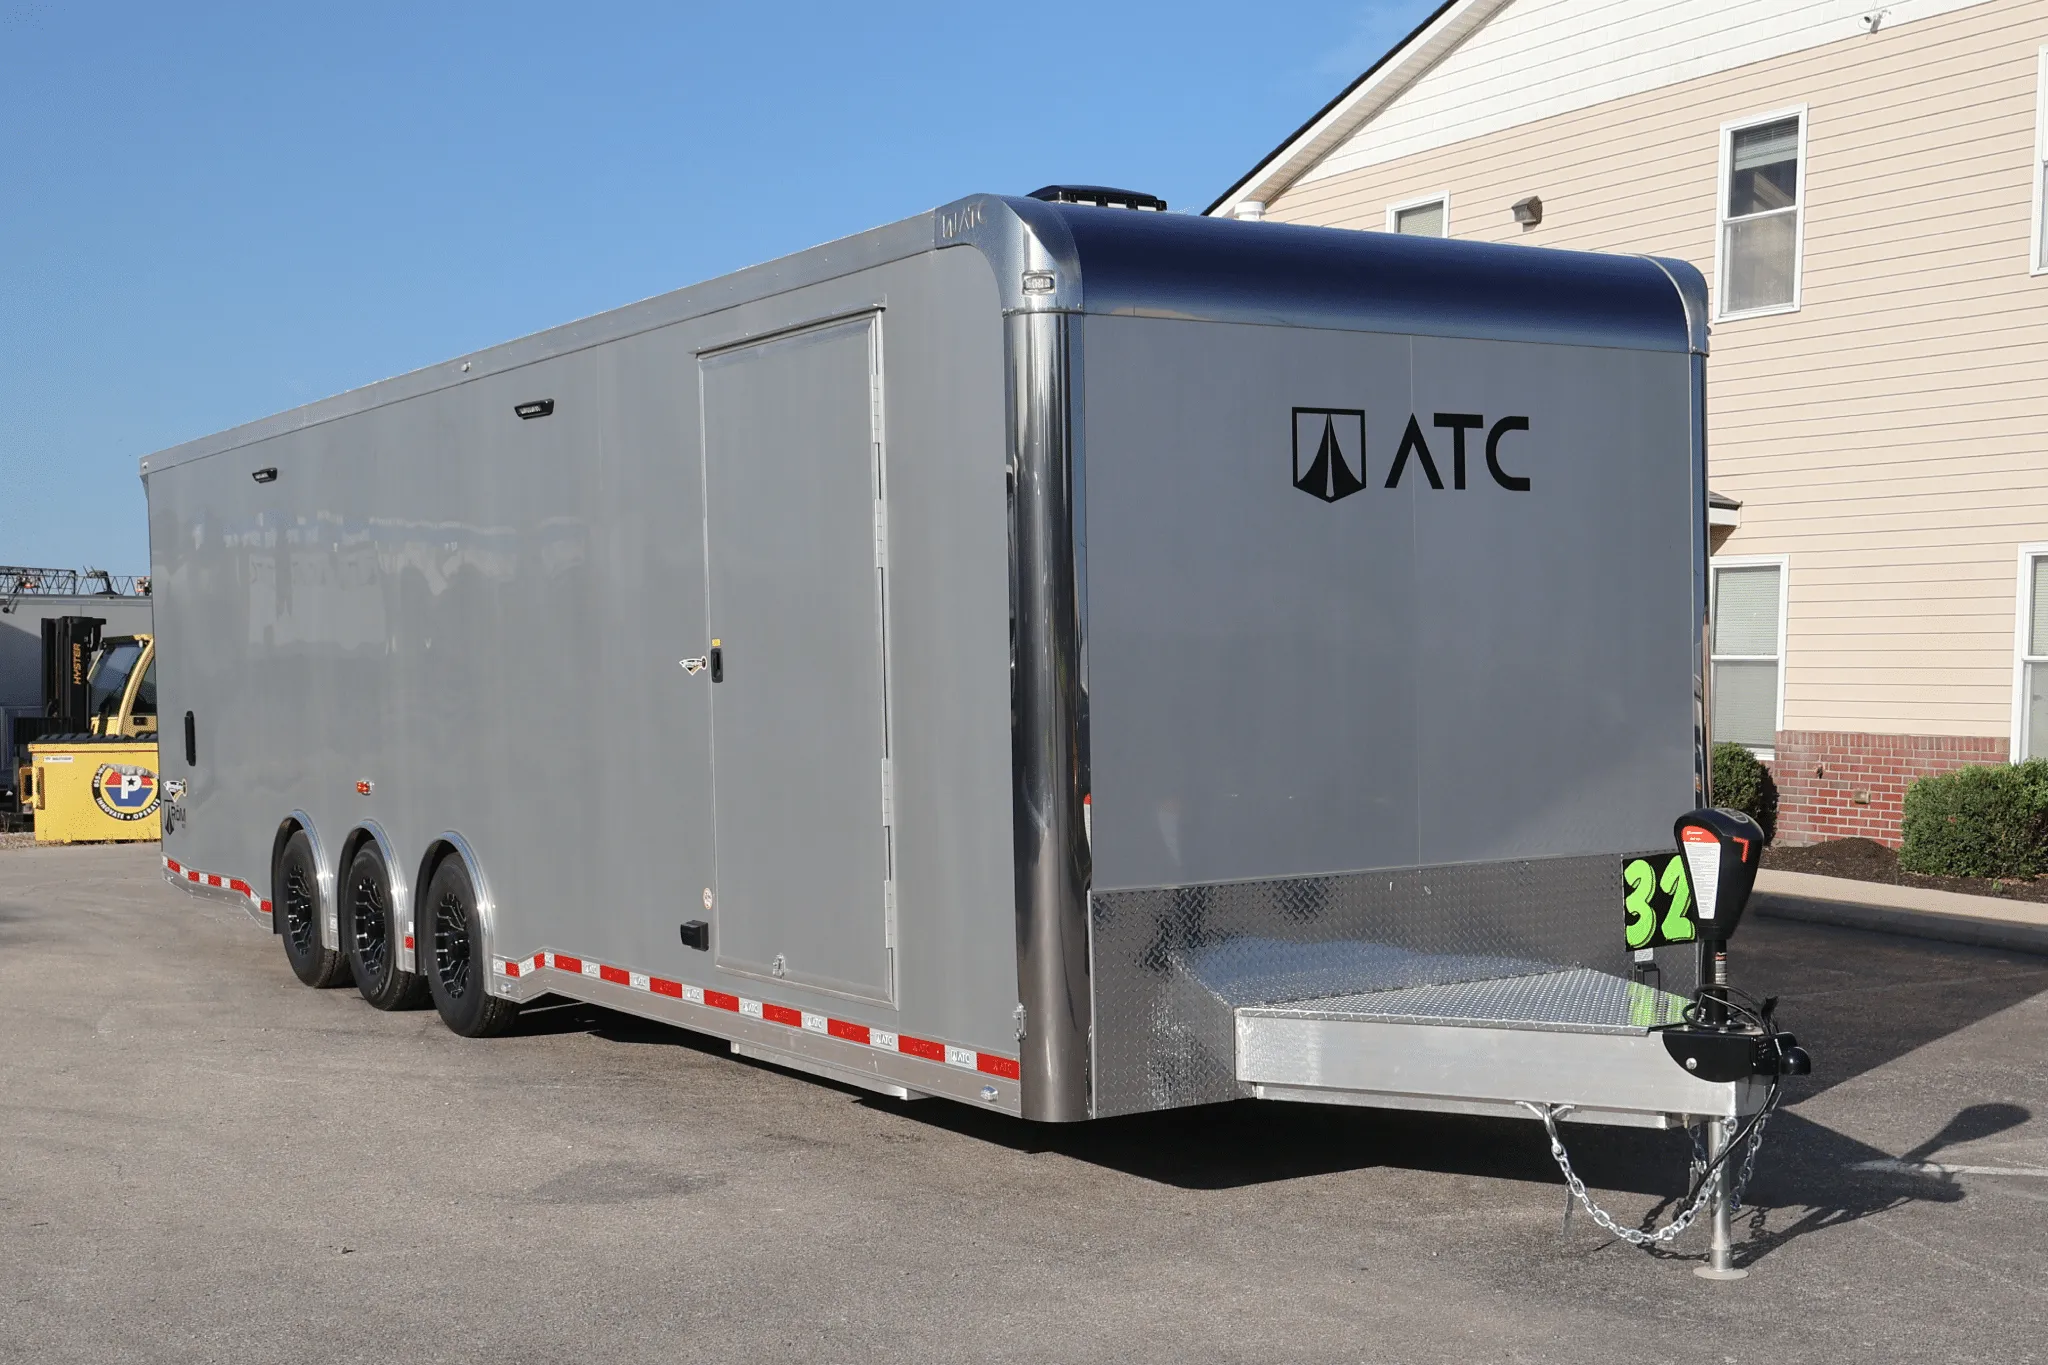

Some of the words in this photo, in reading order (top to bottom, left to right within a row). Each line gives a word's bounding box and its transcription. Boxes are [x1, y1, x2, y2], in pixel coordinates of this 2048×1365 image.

[1384, 412, 1530, 491] ATC
[73, 643, 81, 685] HYSTER
[121, 774, 142, 799] P
[96, 797, 125, 819] INNOVATE
[1624, 855, 1695, 948] 32
